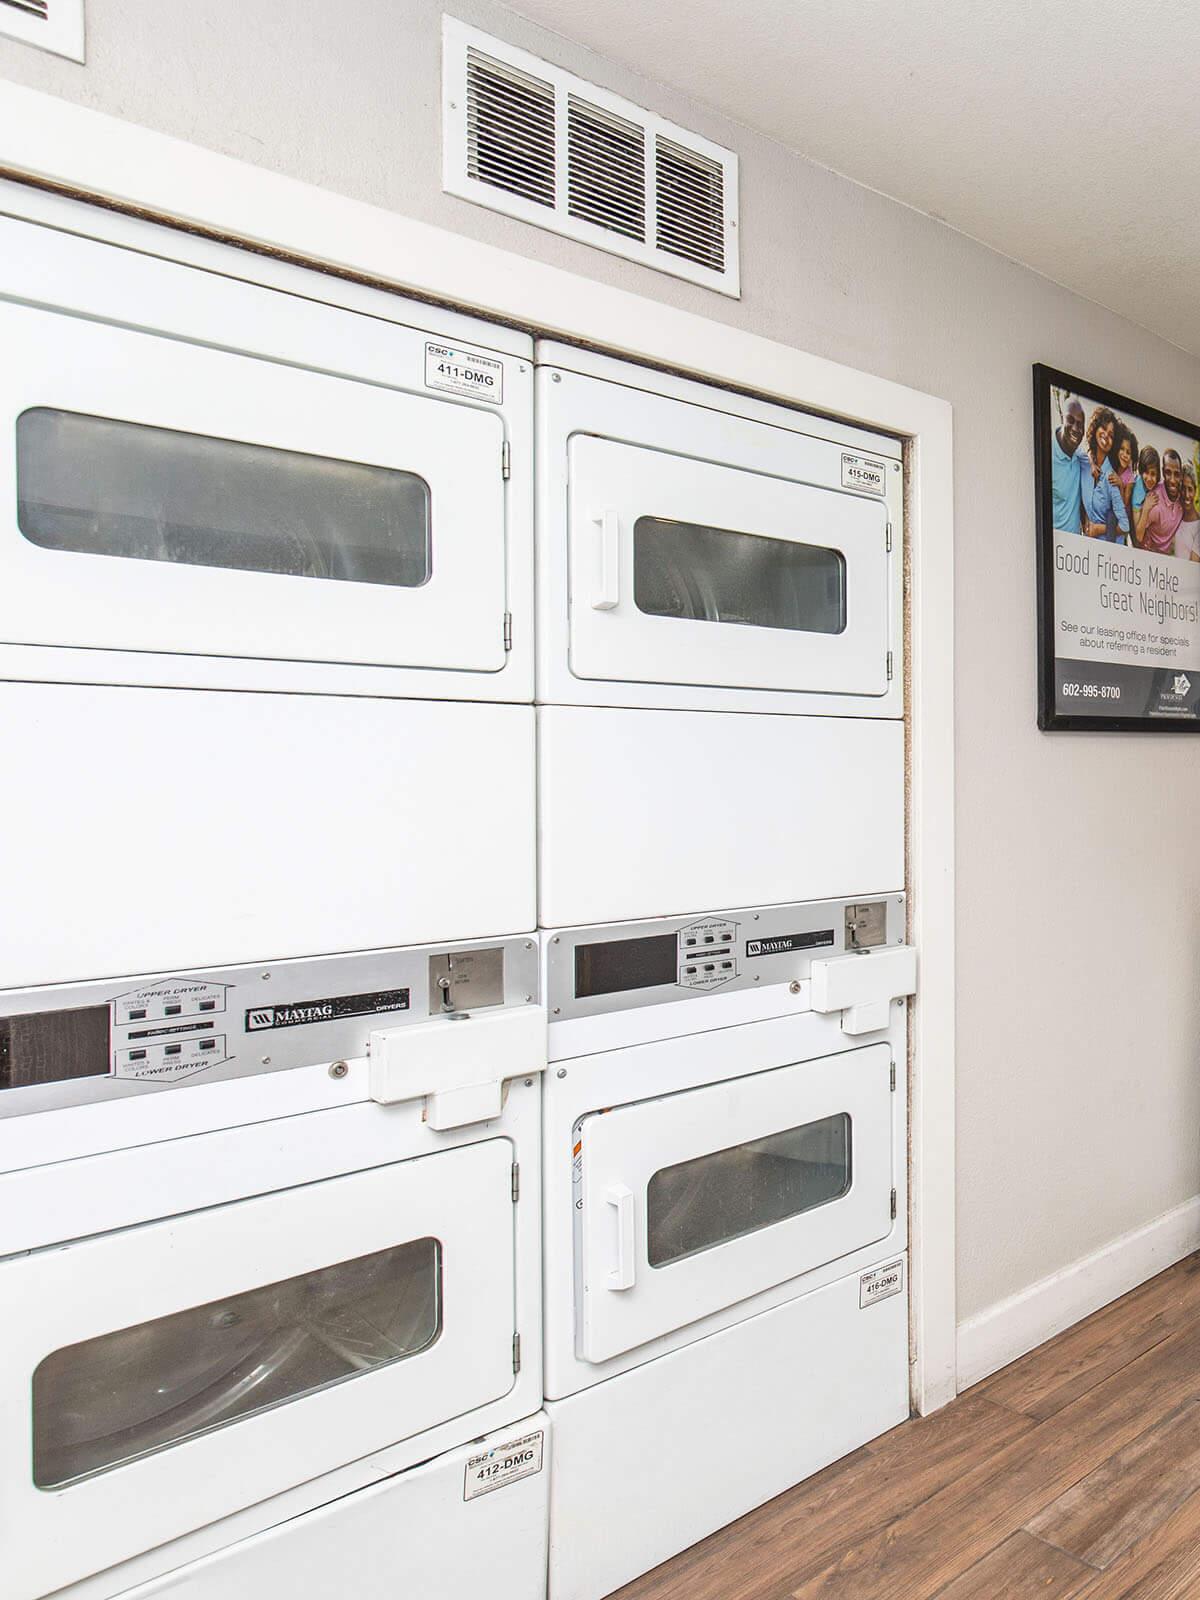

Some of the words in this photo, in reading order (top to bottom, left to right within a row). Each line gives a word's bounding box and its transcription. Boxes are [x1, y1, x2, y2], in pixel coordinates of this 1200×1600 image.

[428, 345, 449, 356] CSC
[437, 363, 494, 386] 411-DMG
[1055, 545, 1089, 575] Good
[1097, 554, 1141, 586] Friends
[1149, 565, 1179, 592] Make
[1100, 584, 1133, 612] Great
[1140, 592, 1199, 624] Neighbors!
[1061, 620, 1078, 632] See
[1080, 625, 1095, 634] our
[1097, 626, 1124, 641] leasing
[1126, 630, 1146, 642] office
[1148, 633, 1159, 643] for
[1160, 635, 1190, 648] specials
[1080, 638, 1104, 649] about
[1106, 639, 1138, 655] referring
[1140, 646, 1145, 654] a
[1146, 646, 1177, 656] resident
[1062, 683, 1121, 699] 602-995-8700
[760, 940, 792, 951] MAYTAG
[137, 988, 171, 999] UPPER
[173, 985, 208, 995] DRYER
[276, 1005, 332, 1023] MAYTAG
[376, 1002, 407, 1012] DRYERS
[275, 1014, 332, 1026] COMMERCIAL
[135, 1066, 173, 1078] LOWER
[175, 1060, 209, 1072] DRYER
[468, 1454, 489, 1467] CSC
[477, 1450, 535, 1479] 412-DMG
